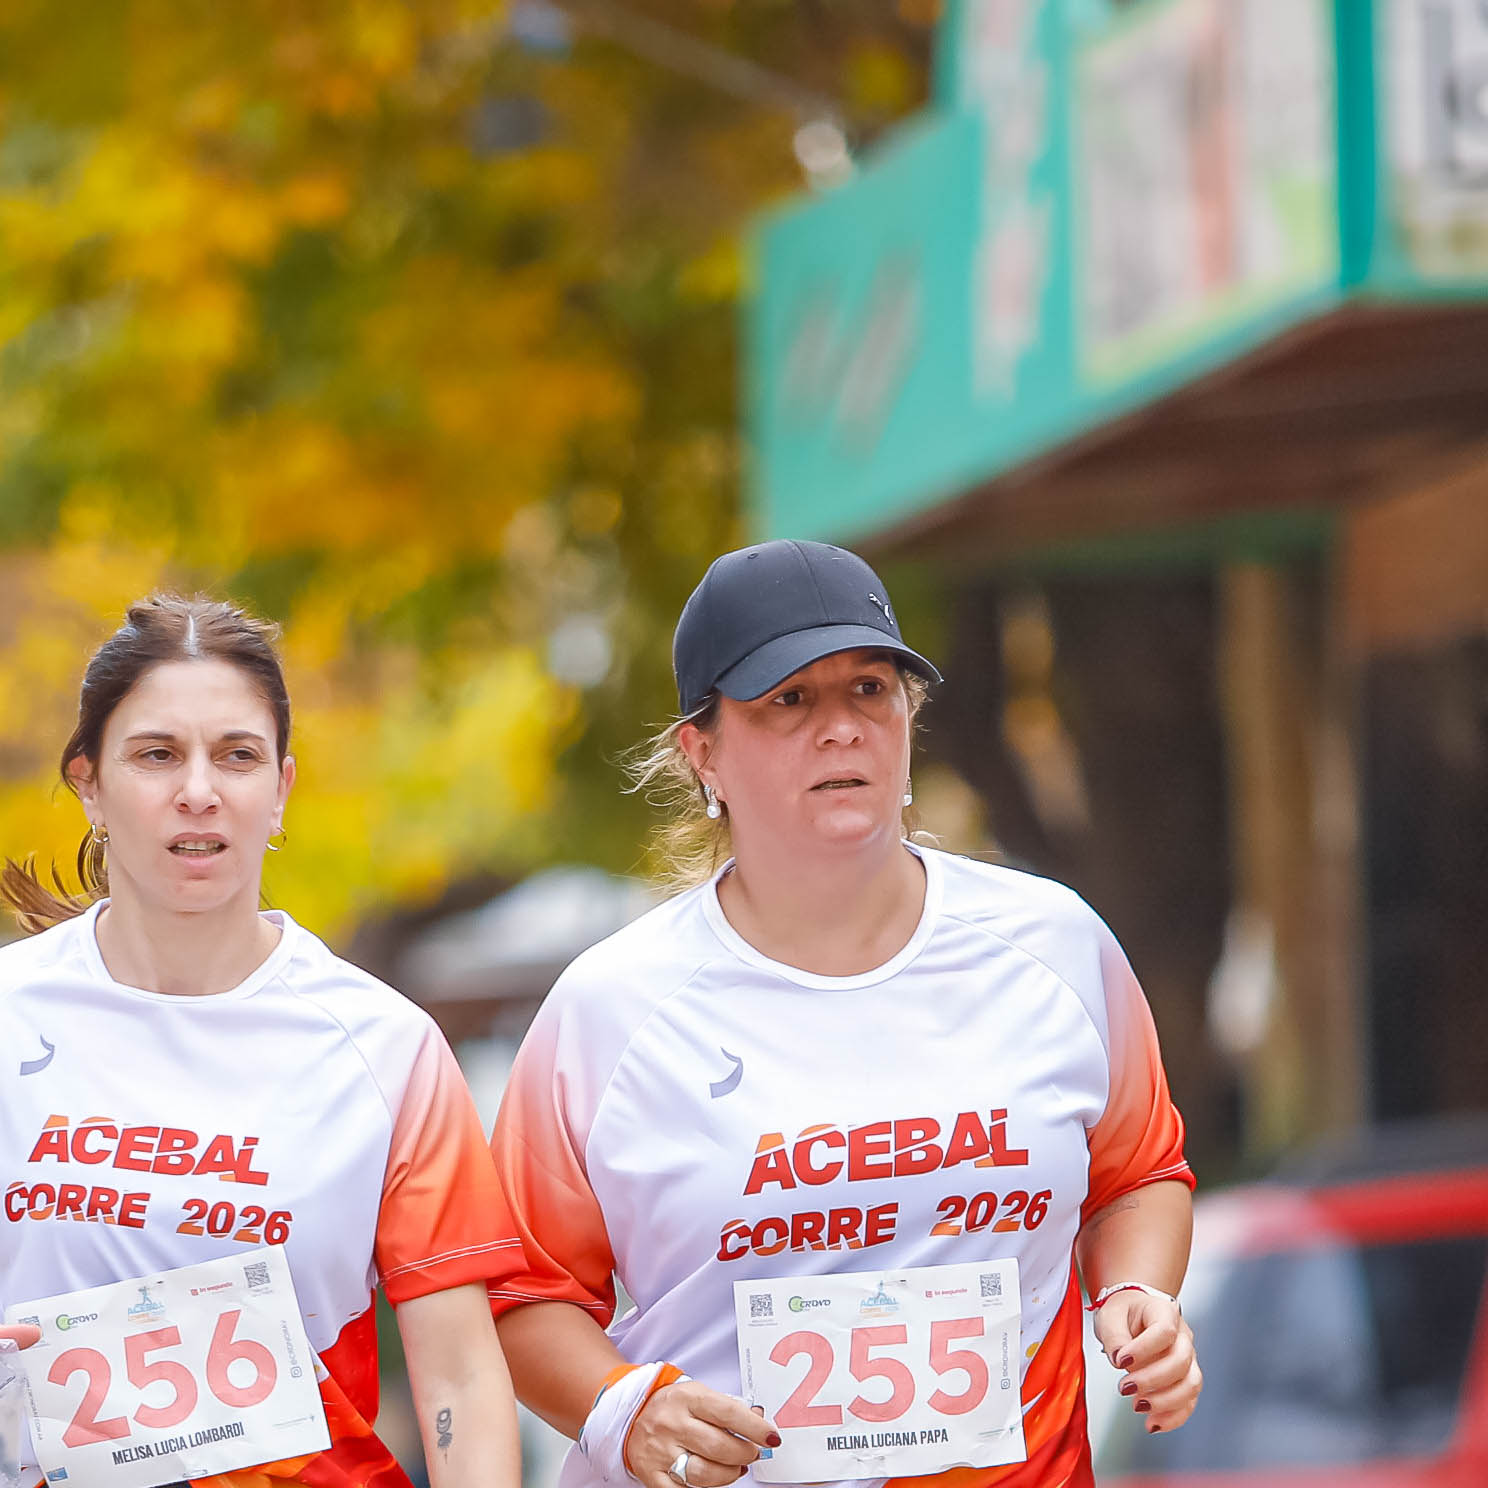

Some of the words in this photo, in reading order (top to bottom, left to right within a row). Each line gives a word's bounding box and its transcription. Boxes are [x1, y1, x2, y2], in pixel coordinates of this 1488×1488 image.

[28, 1114, 270, 1186] ACEBAL
[743, 1108, 1029, 1196] ACEBAL
[5, 1181, 152, 1229] CORRE
[176, 1198, 294, 1246] 2026
[716, 1202, 899, 1262] CORRE
[929, 1189, 1053, 1237] 2026
[47, 1308, 278, 1449] 256
[768, 1316, 990, 1429] 255
[112, 1445, 154, 1465] MELISA
[154, 1436, 188, 1456] LUCIA
[188, 1421, 245, 1448] LOMBARDI
[827, 1435, 869, 1451] MELINA
[871, 1431, 918, 1448] LUCIANA
[920, 1428, 949, 1445] PAPA
